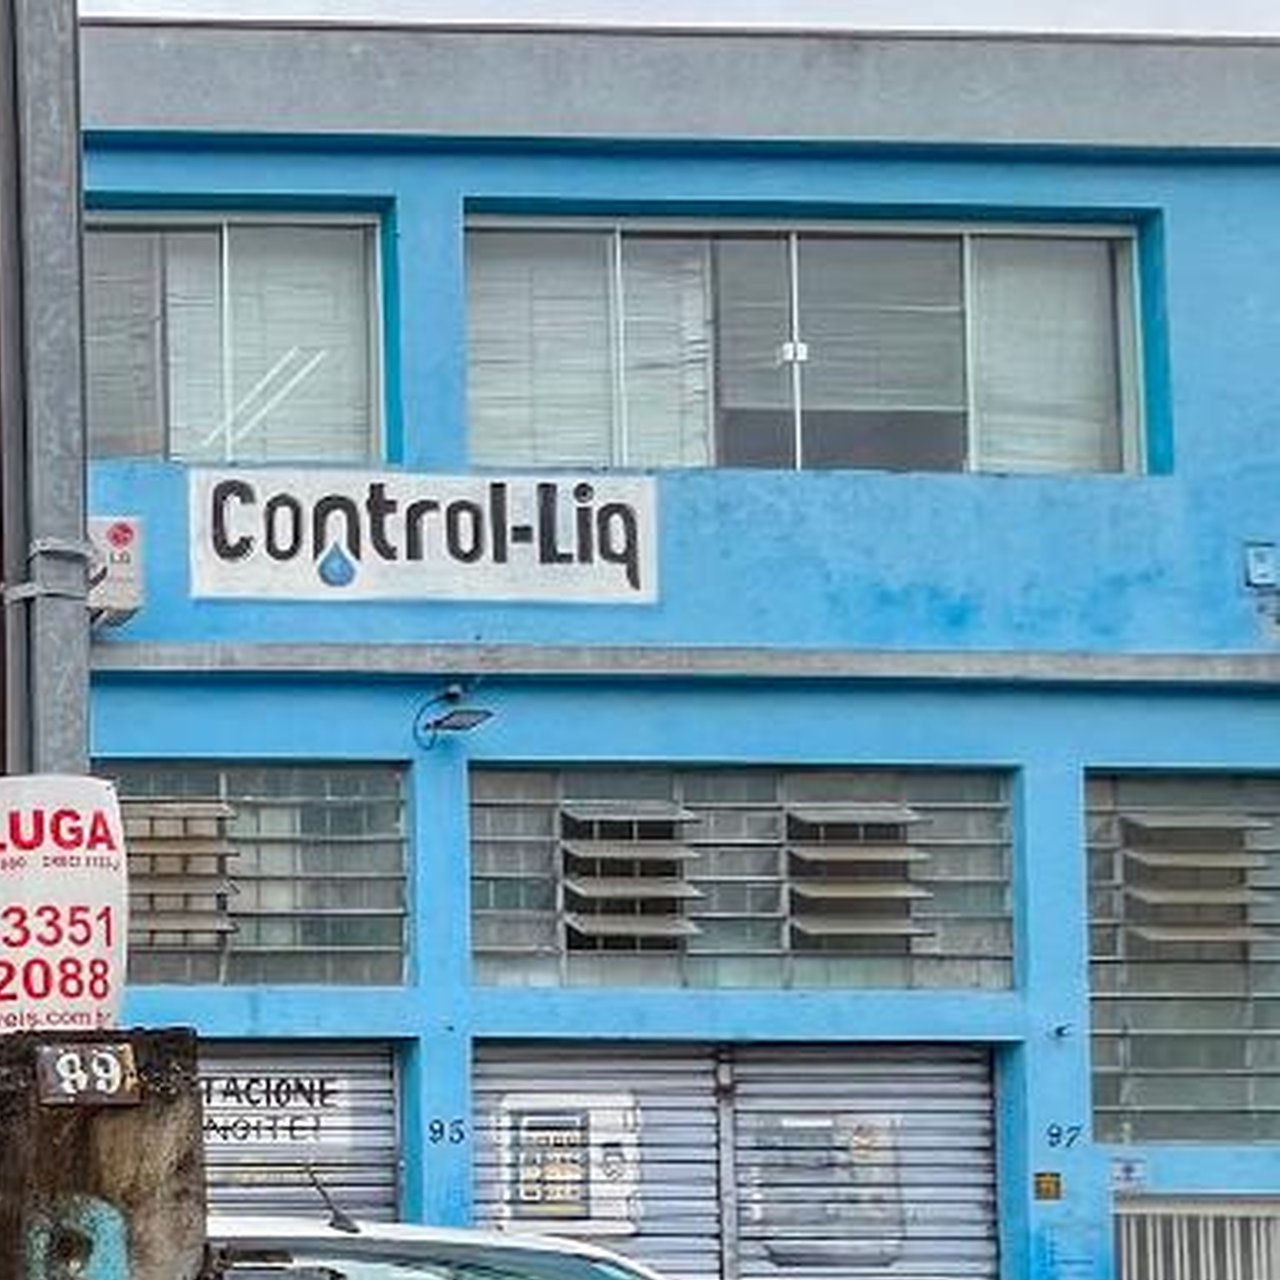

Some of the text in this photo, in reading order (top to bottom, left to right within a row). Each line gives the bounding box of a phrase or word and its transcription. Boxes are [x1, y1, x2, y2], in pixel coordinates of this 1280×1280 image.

[211, 478, 641, 591] Control-Liq
[109, 550, 131, 564] LG
[428, 1118, 465, 1144] 95
[1046, 1122, 1084, 1148] 97
